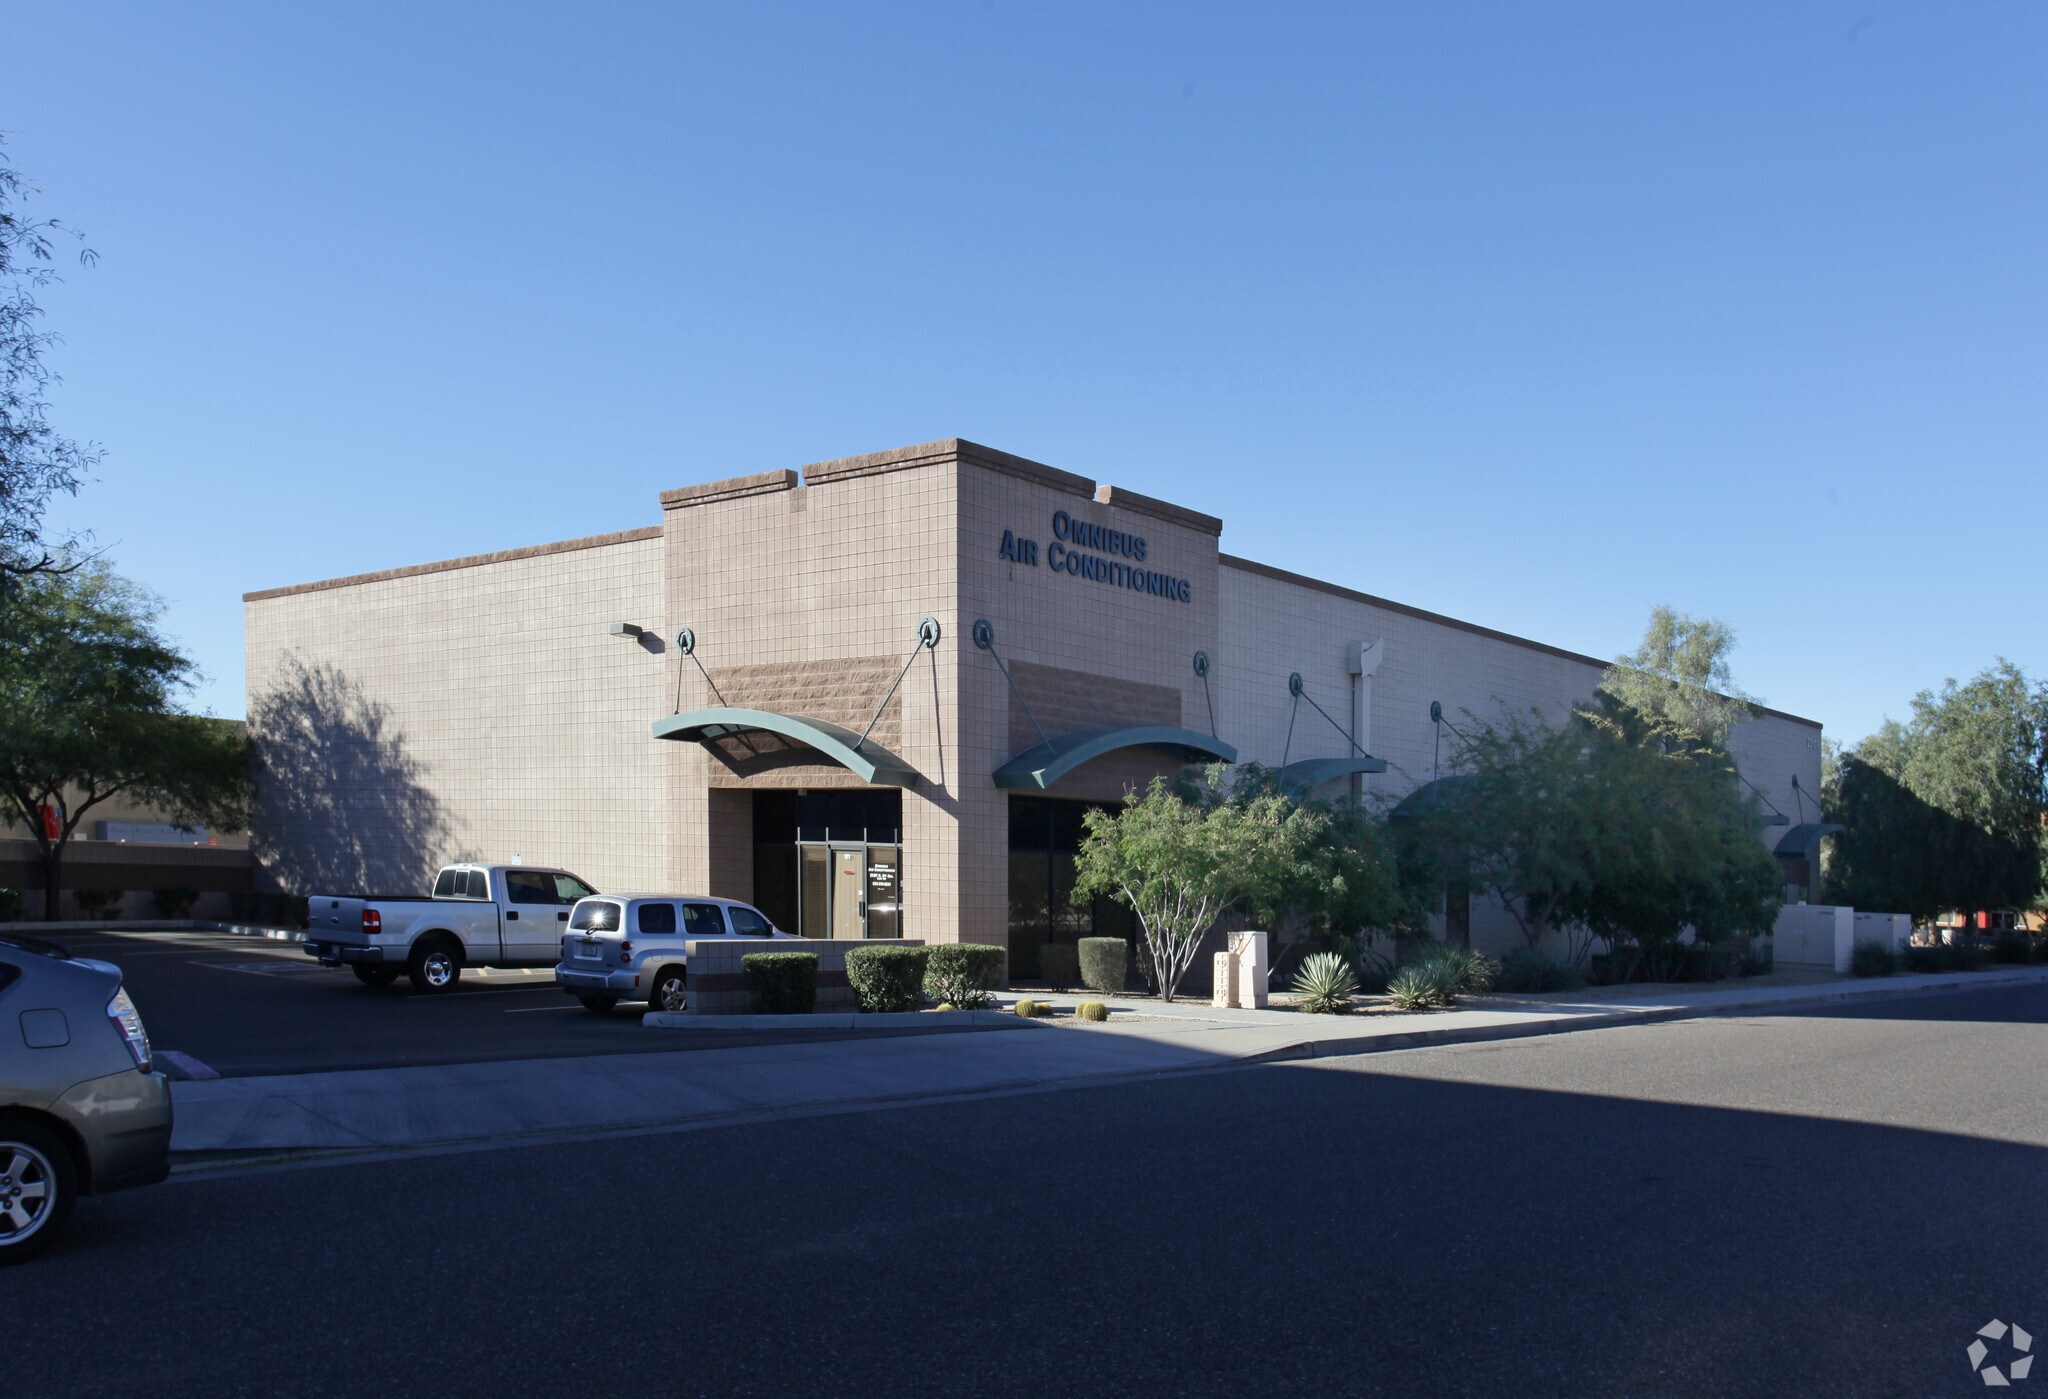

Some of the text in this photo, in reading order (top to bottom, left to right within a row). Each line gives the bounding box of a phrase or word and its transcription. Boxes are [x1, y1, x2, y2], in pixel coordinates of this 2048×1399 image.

[1000, 529, 1191, 603] AIR CONDITIONING
[1053, 510, 1148, 561] OMNIBUS
